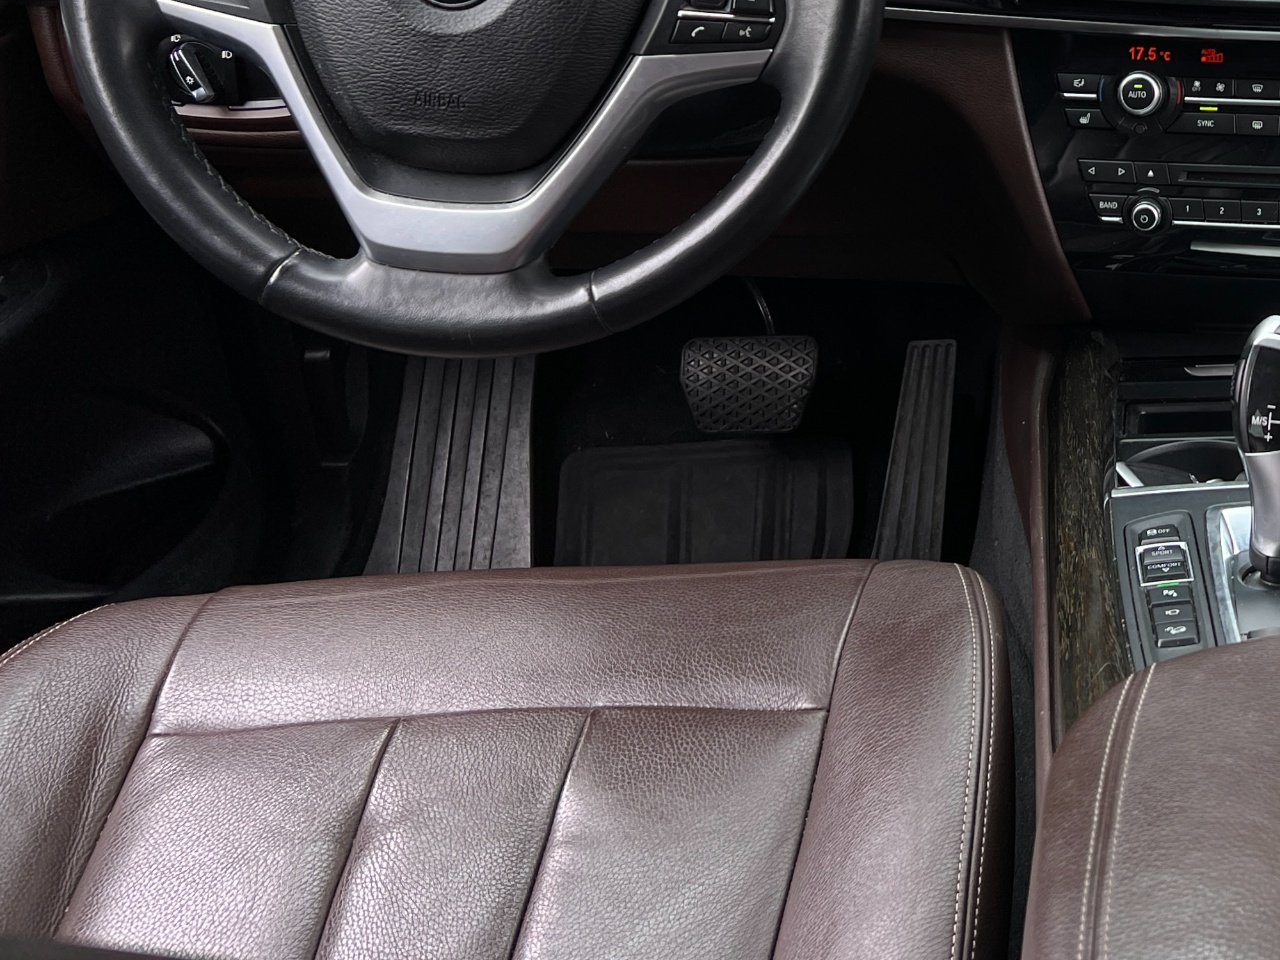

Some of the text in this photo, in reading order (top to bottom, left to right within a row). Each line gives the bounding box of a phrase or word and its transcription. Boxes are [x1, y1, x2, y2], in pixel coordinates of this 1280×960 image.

[1128, 46, 1157, 61] 17.5
[1127, 90, 1147, 99] AUTO
[1197, 119, 1215, 128] SYNC
[1099, 201, 1118, 209] BAND
[1185, 205, 1190, 213] 1
[1219, 206, 1225, 215] 2
[1256, 208, 1262, 216] 3
[1251, 415, 1268, 426] M/S
